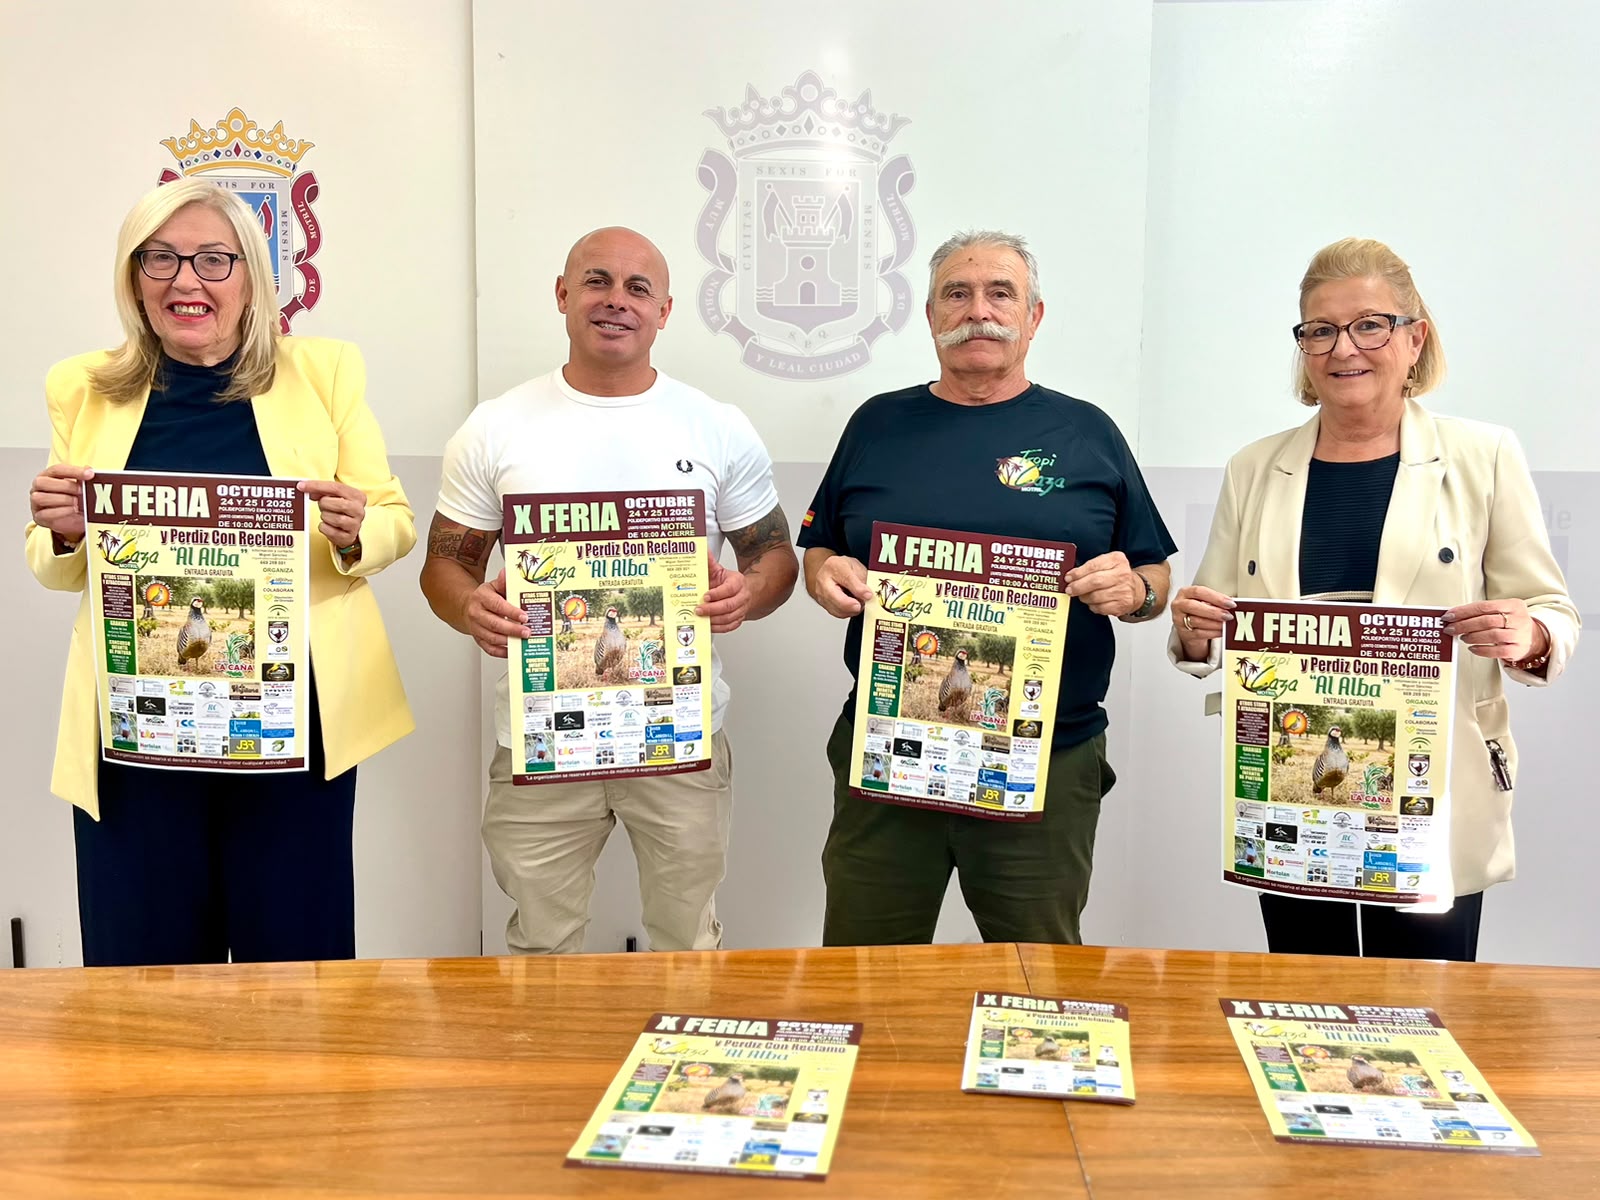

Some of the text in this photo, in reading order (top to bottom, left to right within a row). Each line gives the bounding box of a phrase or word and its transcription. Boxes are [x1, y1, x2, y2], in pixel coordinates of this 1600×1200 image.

[756, 166, 857, 177] SEXIS FOR
[250, 182, 275, 190] FOR
[298, 201, 318, 239] MOTRIL
[706, 198, 725, 231] MUY
[886, 193, 910, 241] MOTRIL
[281, 210, 289, 261] MENSIS
[742, 201, 751, 271] CIVITAS
[864, 205, 872, 270] MENSIS
[308, 278, 316, 293] DE
[704, 278, 720, 324] NOBLE
[896, 292, 906, 311] DE
[756, 352, 861, 373] Y LEAL CIUDAD
[1020, 448, 1057, 471] Tropi
[1015, 465, 1066, 496] Caza
[92, 483, 210, 518] X FERIA
[216, 485, 294, 498] OCTUBRE
[624, 495, 695, 509] OCTUBRE
[256, 514, 292, 522] MOTRIL
[512, 501, 620, 534] X FERIA
[660, 522, 694, 530] MOTRIL
[160, 528, 293, 547] y Perdiz Con Reclamo
[112, 537, 159, 573] Caza
[576, 539, 696, 558] y Perdiz Con Reclamo
[877, 533, 985, 574] X FERIA
[990, 542, 1065, 560] OCTUBRE
[531, 553, 576, 590] Caza
[1035, 560, 1060, 569] 2026
[1024, 573, 1059, 584] MOTRIL
[1029, 582, 1059, 591] CIERRE
[888, 585, 933, 623] Caza
[935, 582, 1058, 609] y Perdiz Con Reclamo
[953, 620, 997, 632] ENTRADA GRATUITA
[1234, 611, 1353, 647] X FERIA
[1359, 613, 1444, 628] OCTUBRE
[1412, 629, 1440, 637] 2026
[1400, 643, 1440, 653] MOTRIL
[1300, 657, 1440, 679] y Perdiz Con Reclamo
[1250, 664, 1298, 701] Caza
[1323, 697, 1374, 707] ENTRADA GRATUITA
[236, 739, 254, 750] JBR
[652, 744, 669, 755] JBR
[982, 787, 999, 801] JBR
[1370, 871, 1390, 883] JBR
[983, 994, 997, 1006] X
[1001, 995, 1059, 1012] FERIA
[1230, 1000, 1256, 1016] X
[1258, 1002, 1349, 1020] FERIA
[655, 1016, 769, 1036] X FERIA
[1313, 1022, 1440, 1037] Perdiz Con Reclamo
[723, 1039, 762, 1050] Perdiz
[764, 1041, 789, 1050] Con
[791, 1043, 846, 1053] Reclamo
